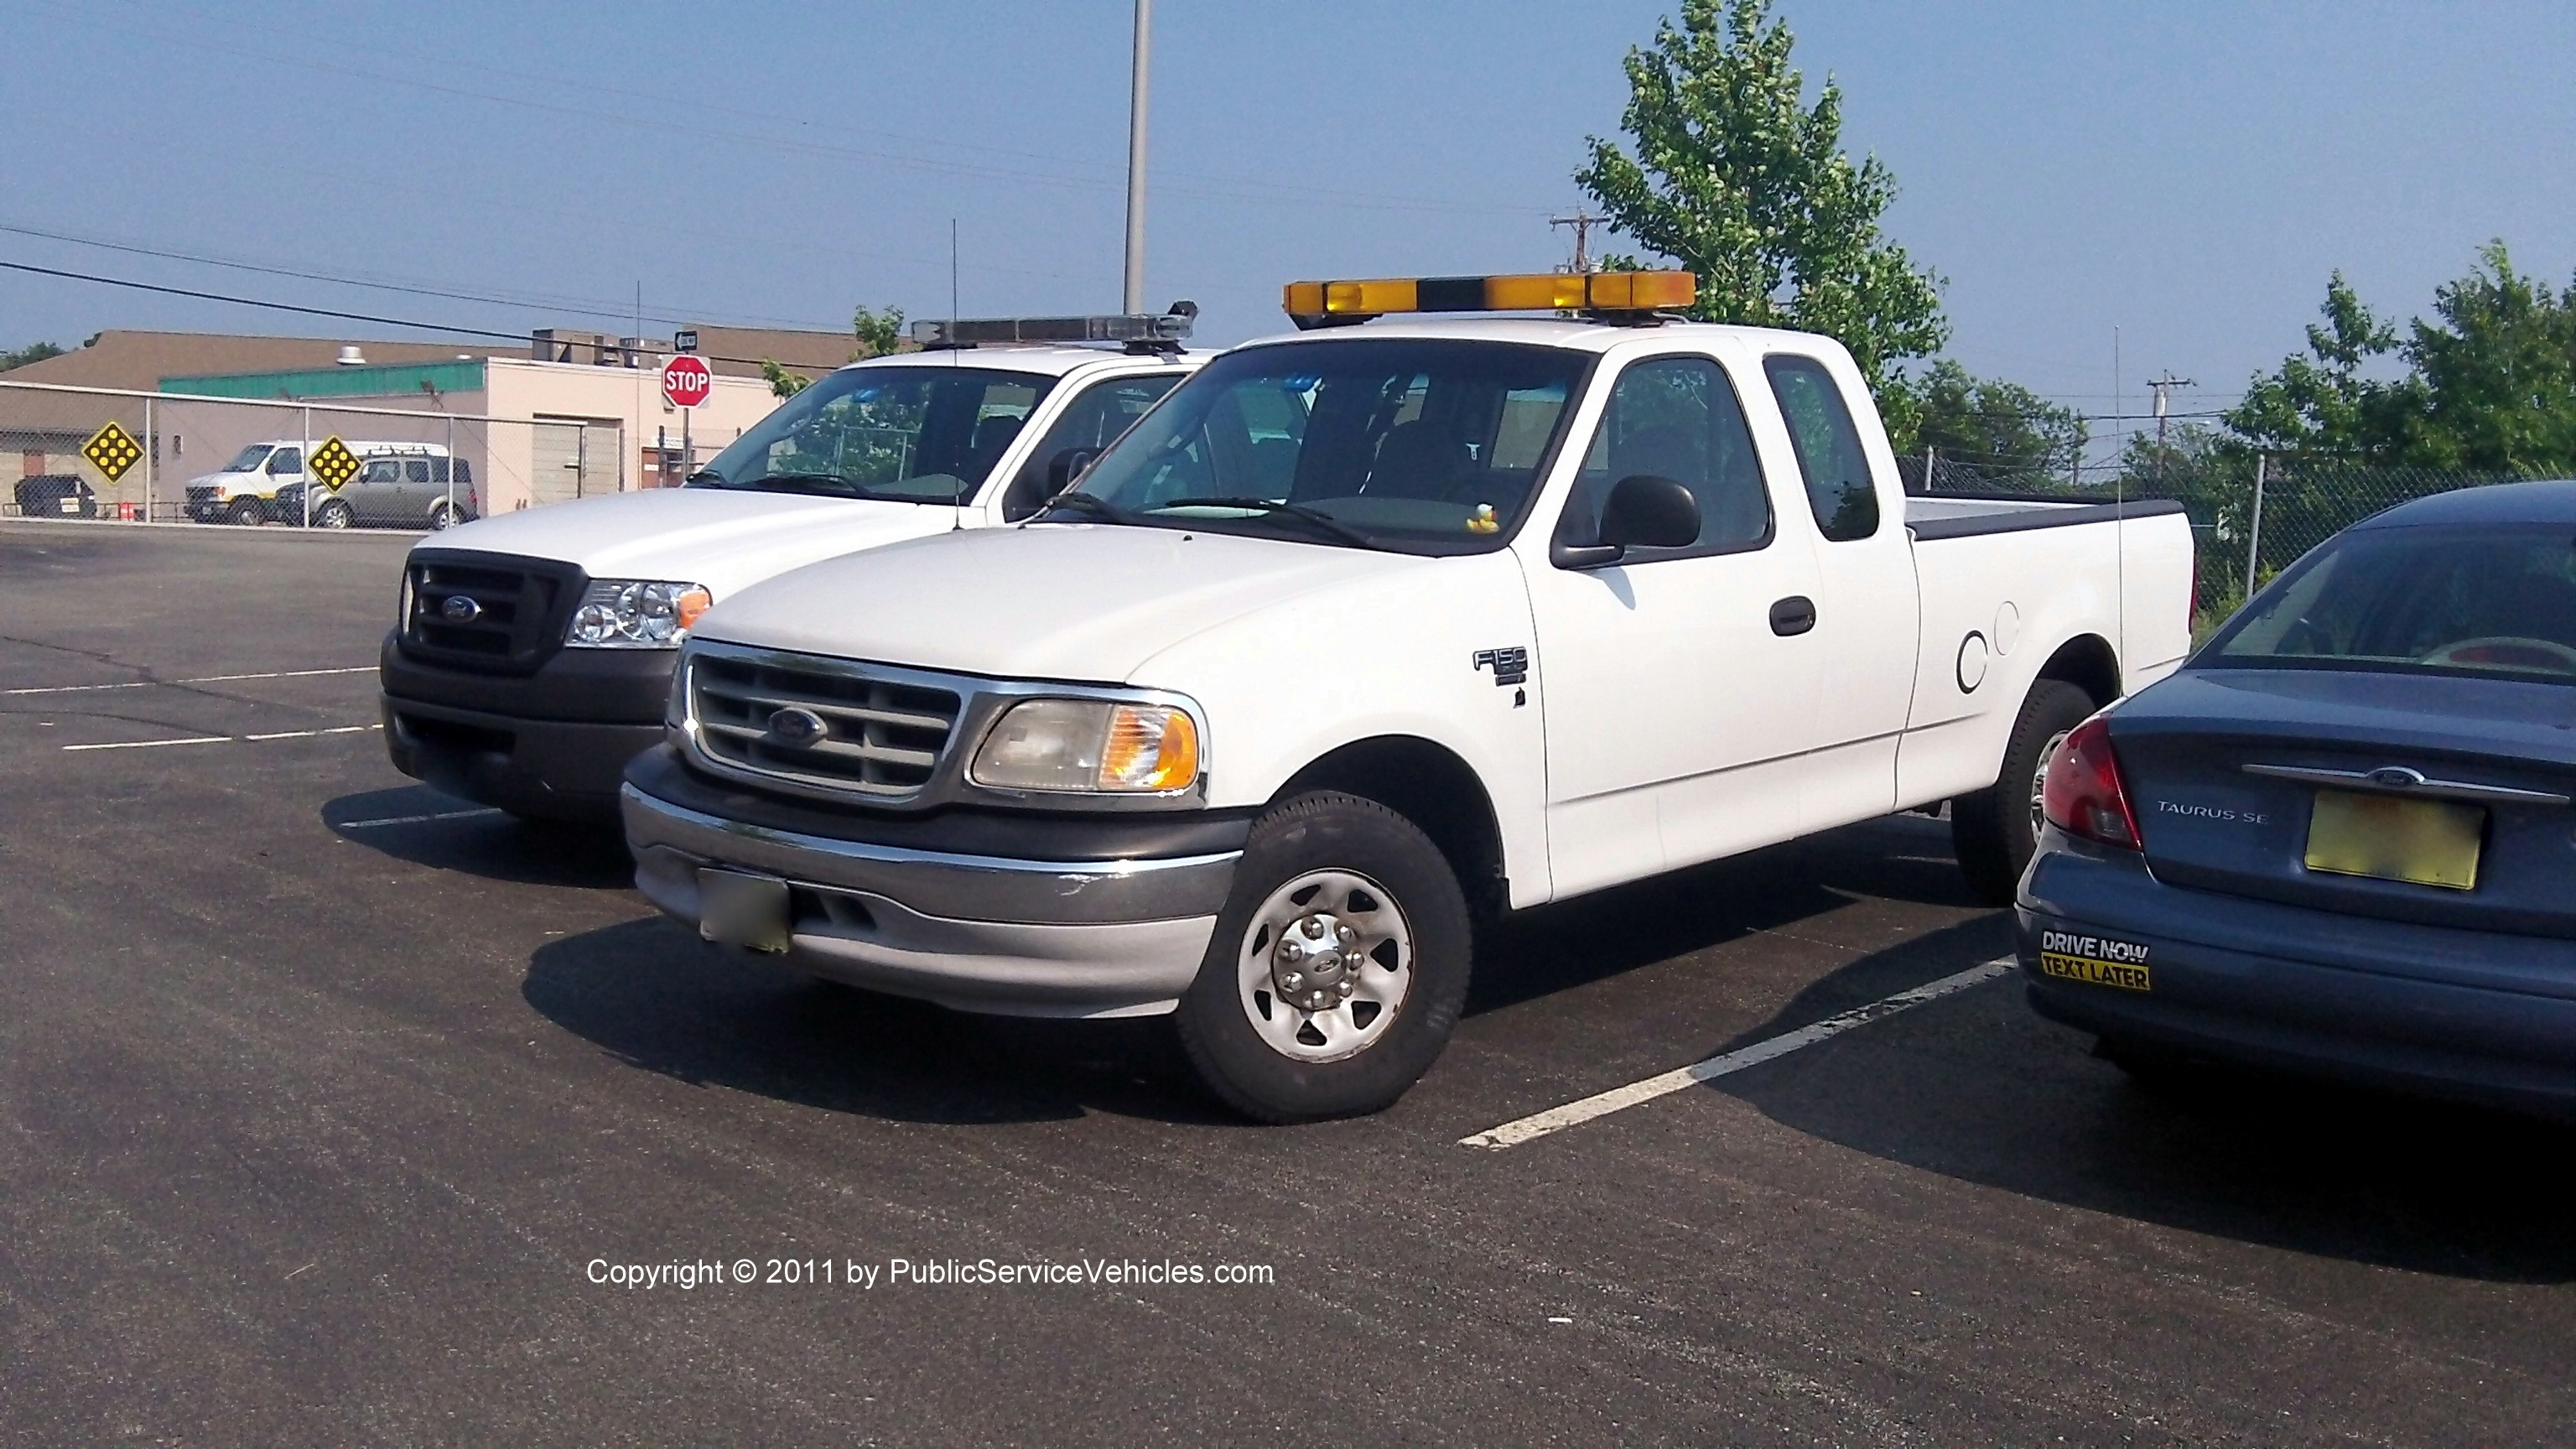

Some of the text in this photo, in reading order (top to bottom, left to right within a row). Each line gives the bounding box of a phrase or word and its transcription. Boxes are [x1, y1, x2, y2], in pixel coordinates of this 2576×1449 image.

[666, 370, 708, 392] STOP
[2158, 800, 2268, 825] TAURUS SE
[2043, 930, 2149, 963] DRIVE NOW
[2043, 956, 2148, 988] TEXT LATER
